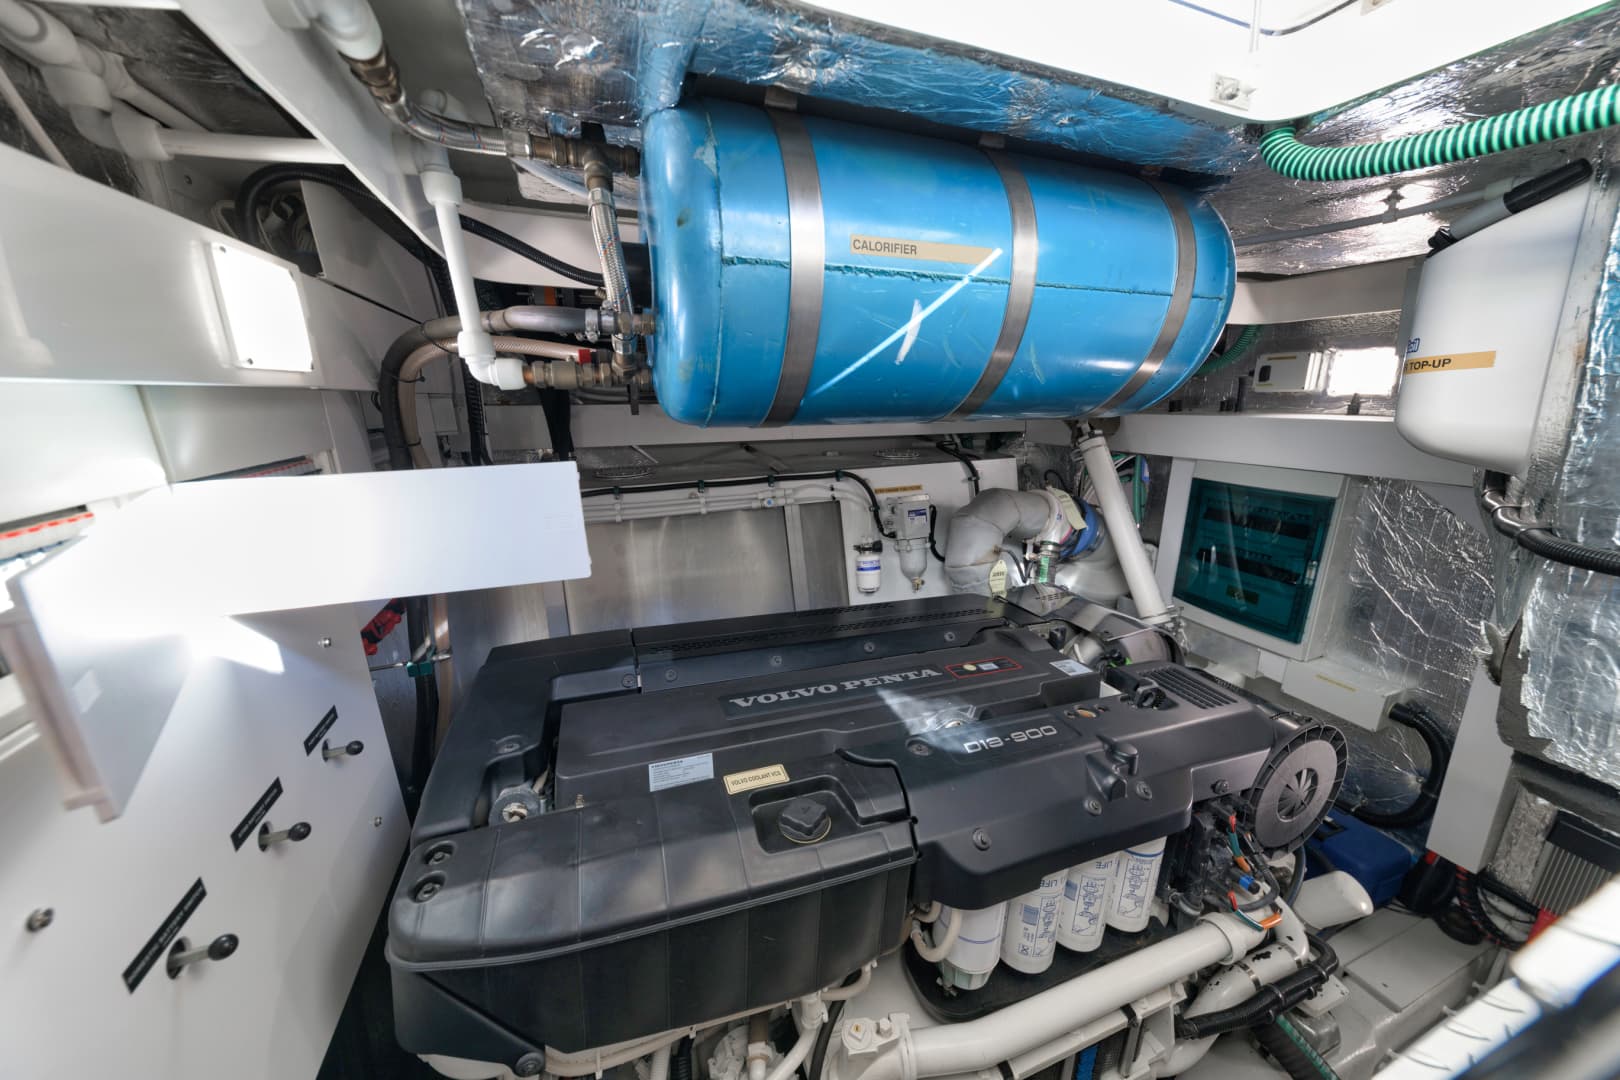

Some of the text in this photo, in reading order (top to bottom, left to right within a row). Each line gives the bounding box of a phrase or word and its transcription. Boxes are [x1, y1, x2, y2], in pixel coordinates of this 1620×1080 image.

[852, 238, 918, 255] CALORIFIER
[1409, 358, 1452, 371] TOP-UP
[729, 668, 943, 709] VOLVO PENTA
[963, 725, 1058, 754] D13-900
